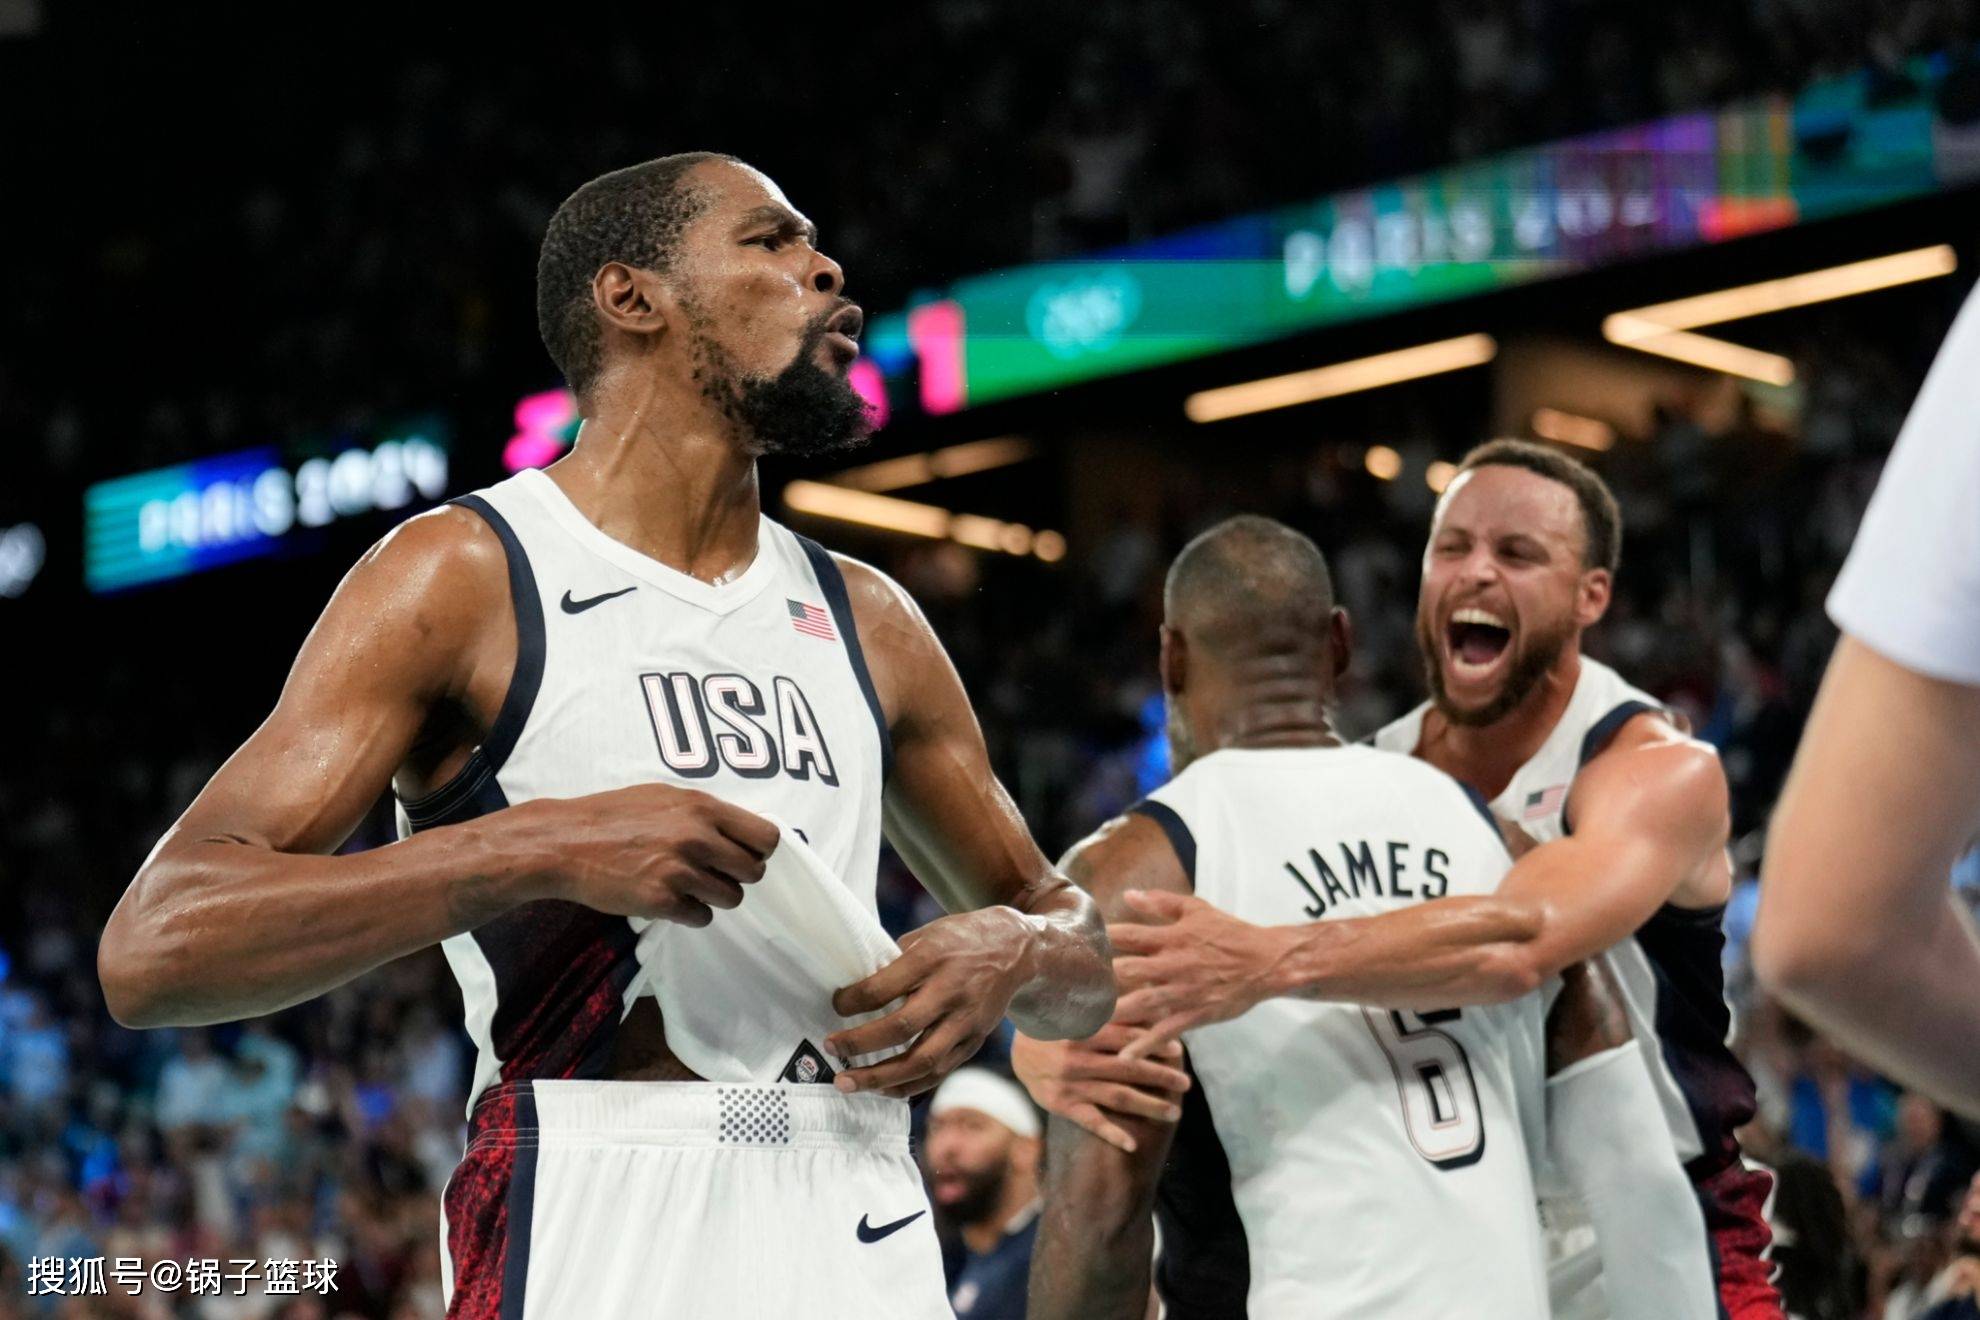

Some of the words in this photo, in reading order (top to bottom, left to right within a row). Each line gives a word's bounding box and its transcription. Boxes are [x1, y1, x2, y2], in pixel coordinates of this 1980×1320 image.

[139, 467, 294, 552] PARIS
[296, 438, 447, 527] 2024
[640, 673, 840, 788] USA
[1283, 840, 1450, 918] JAMES
[1361, 1006, 1486, 1172] 6
